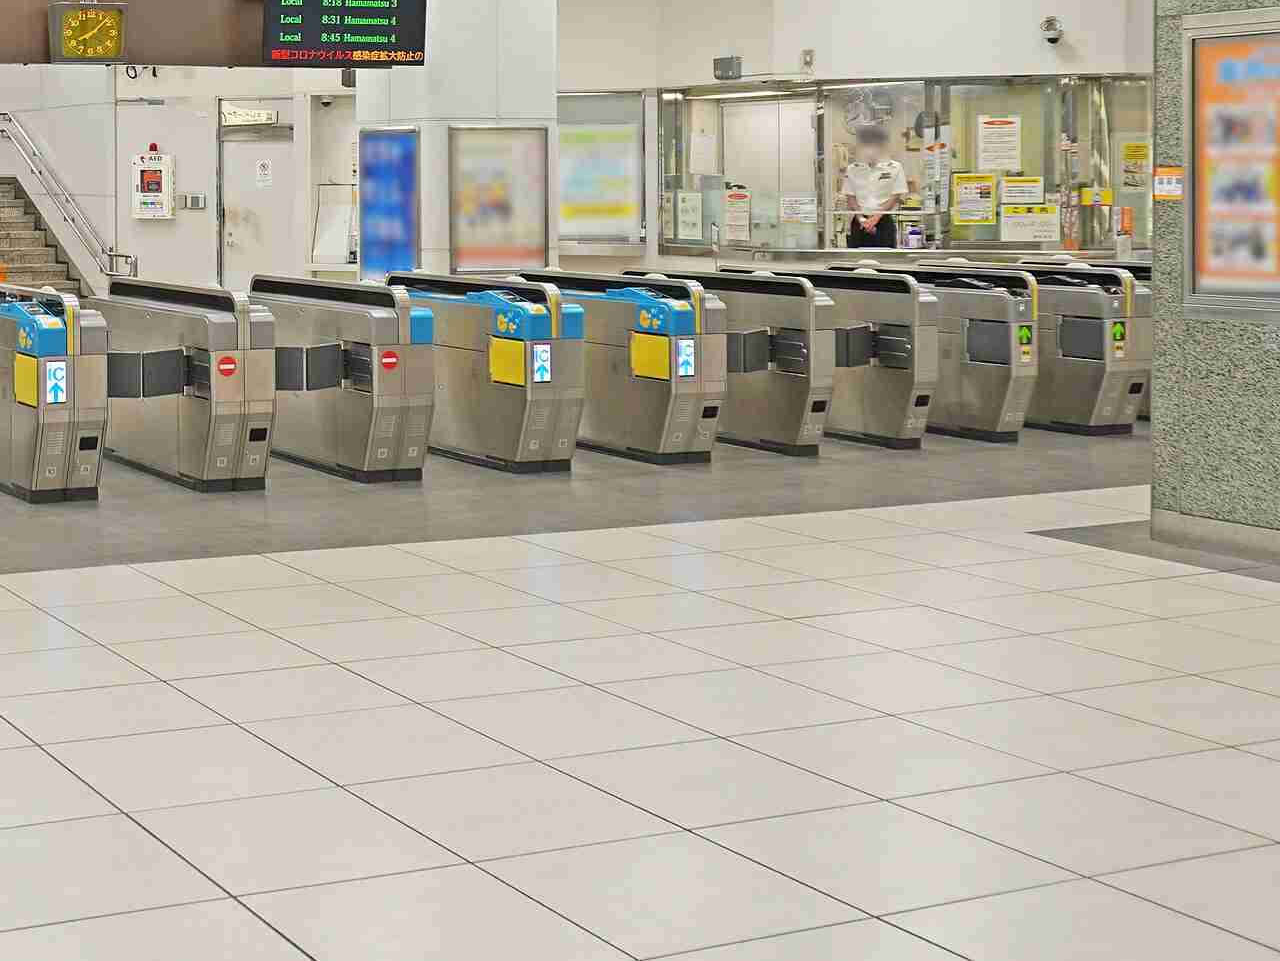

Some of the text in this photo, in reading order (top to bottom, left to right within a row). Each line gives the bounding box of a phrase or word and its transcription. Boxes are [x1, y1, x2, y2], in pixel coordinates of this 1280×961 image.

[280, 15, 396, 25] Local 8:31 Hamamatsu 4
[279, 32, 396, 43] Local 8:45 Hamamatsu 4
[535, 349, 549, 363] IC
[47, 367, 65, 382] IC
